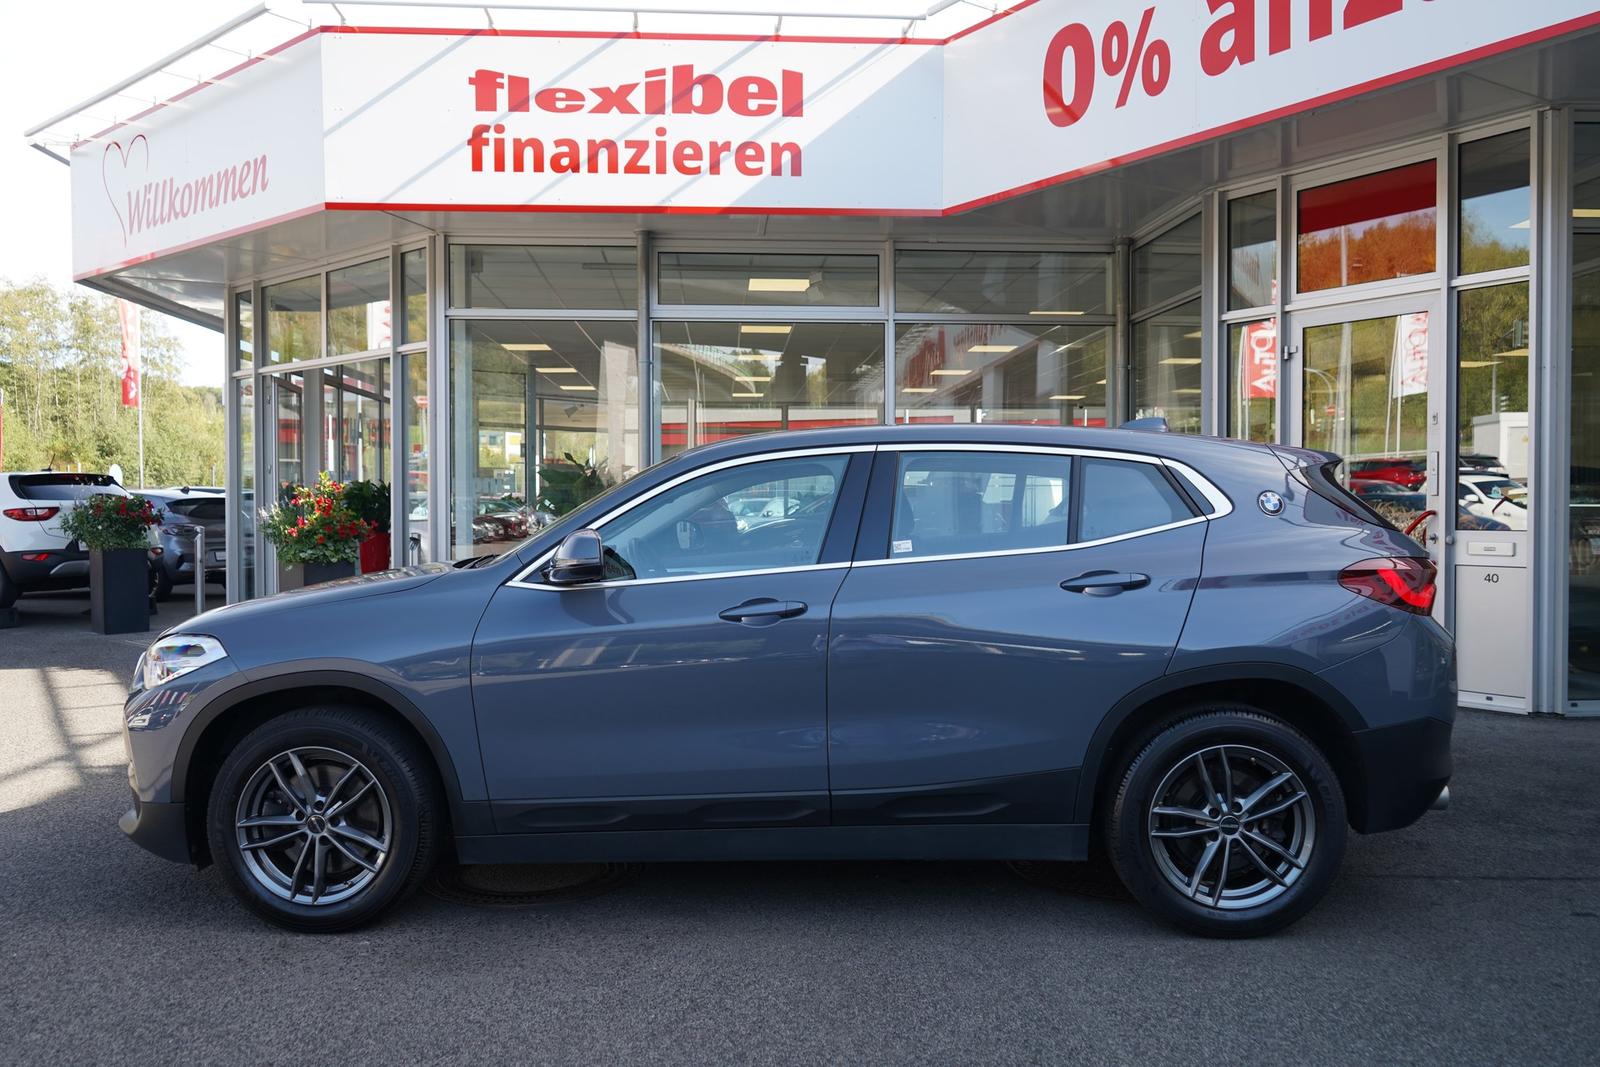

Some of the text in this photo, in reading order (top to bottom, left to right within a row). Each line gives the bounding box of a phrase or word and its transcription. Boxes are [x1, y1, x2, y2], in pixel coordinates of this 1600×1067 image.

[468, 64, 804, 118] flexibel
[1043, 6, 1171, 127] 0%
[467, 123, 803, 177] finanzieren
[127, 154, 269, 236] Willkommen
[1484, 573, 1499, 583] 40
